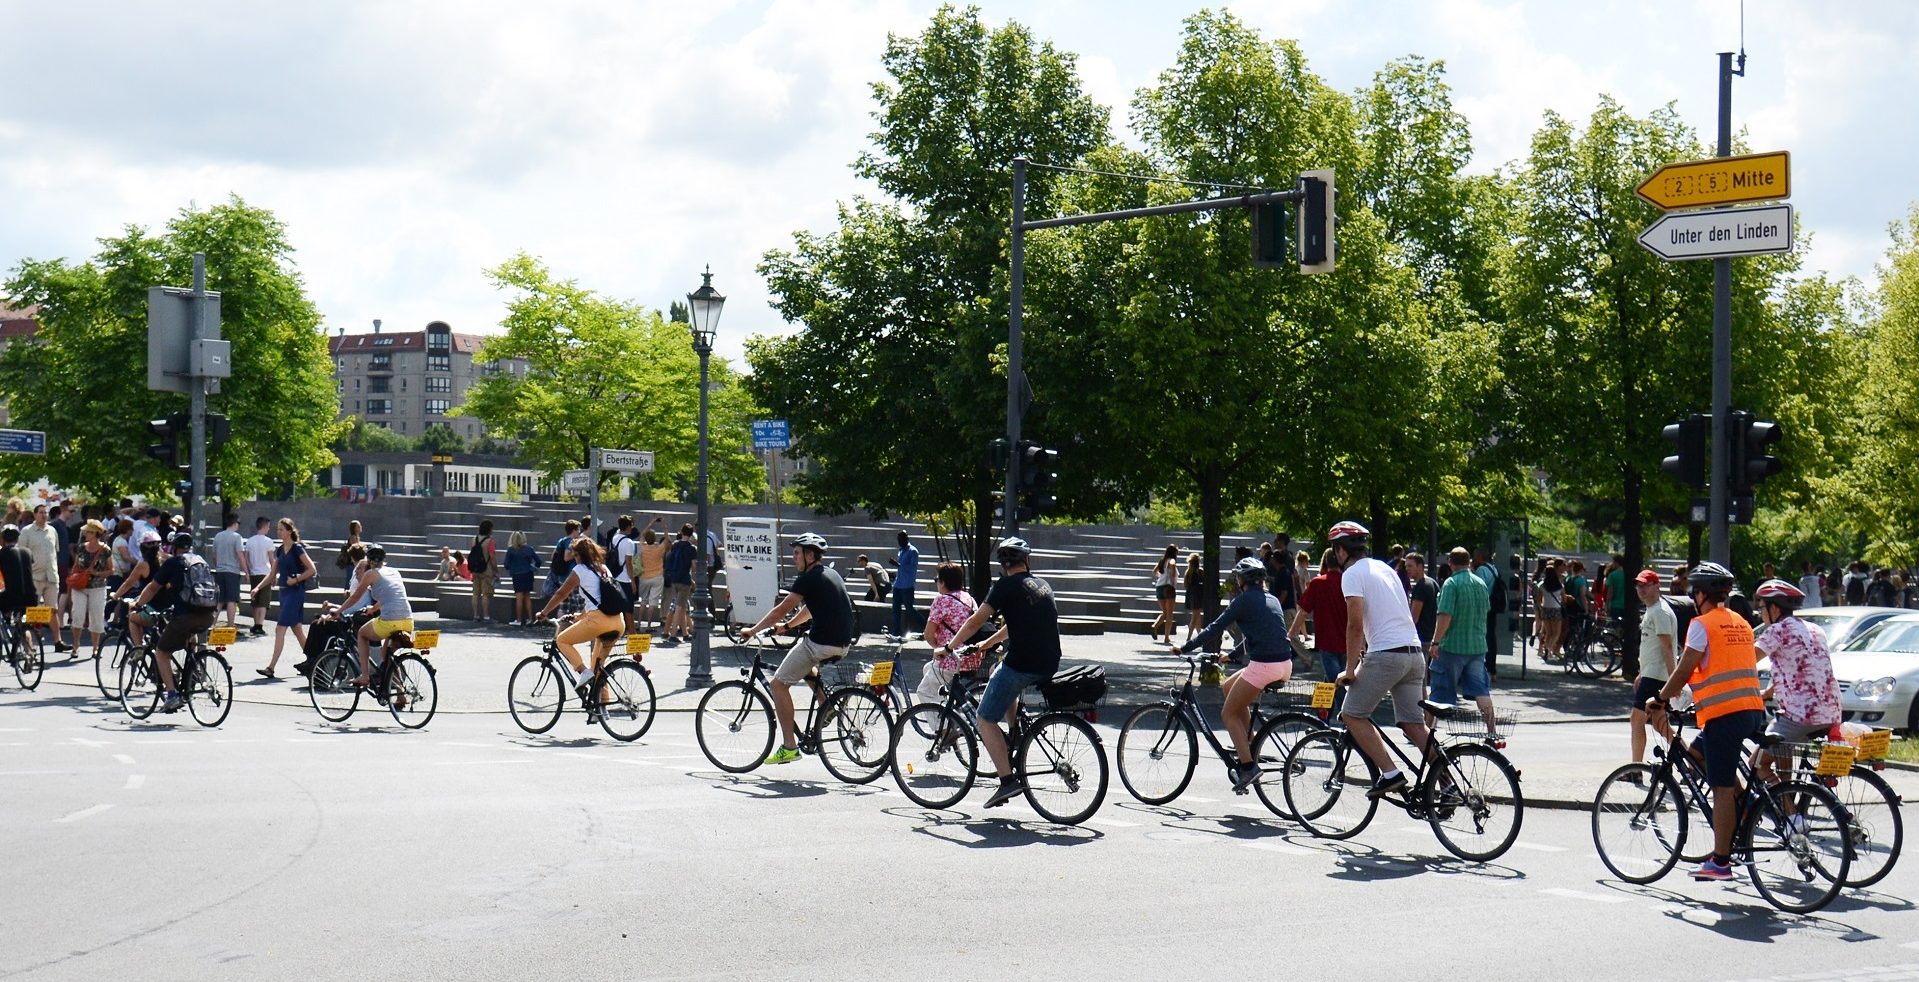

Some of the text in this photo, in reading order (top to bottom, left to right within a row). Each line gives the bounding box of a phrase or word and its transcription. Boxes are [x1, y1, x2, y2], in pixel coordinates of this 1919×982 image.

[1676, 170, 1775, 193] 2 5 Mitte
[1671, 221, 1778, 245] Unter den Linden
[606, 454, 649, 468] Ebertstraße
[727, 544, 772, 554] RENT A BIKE
